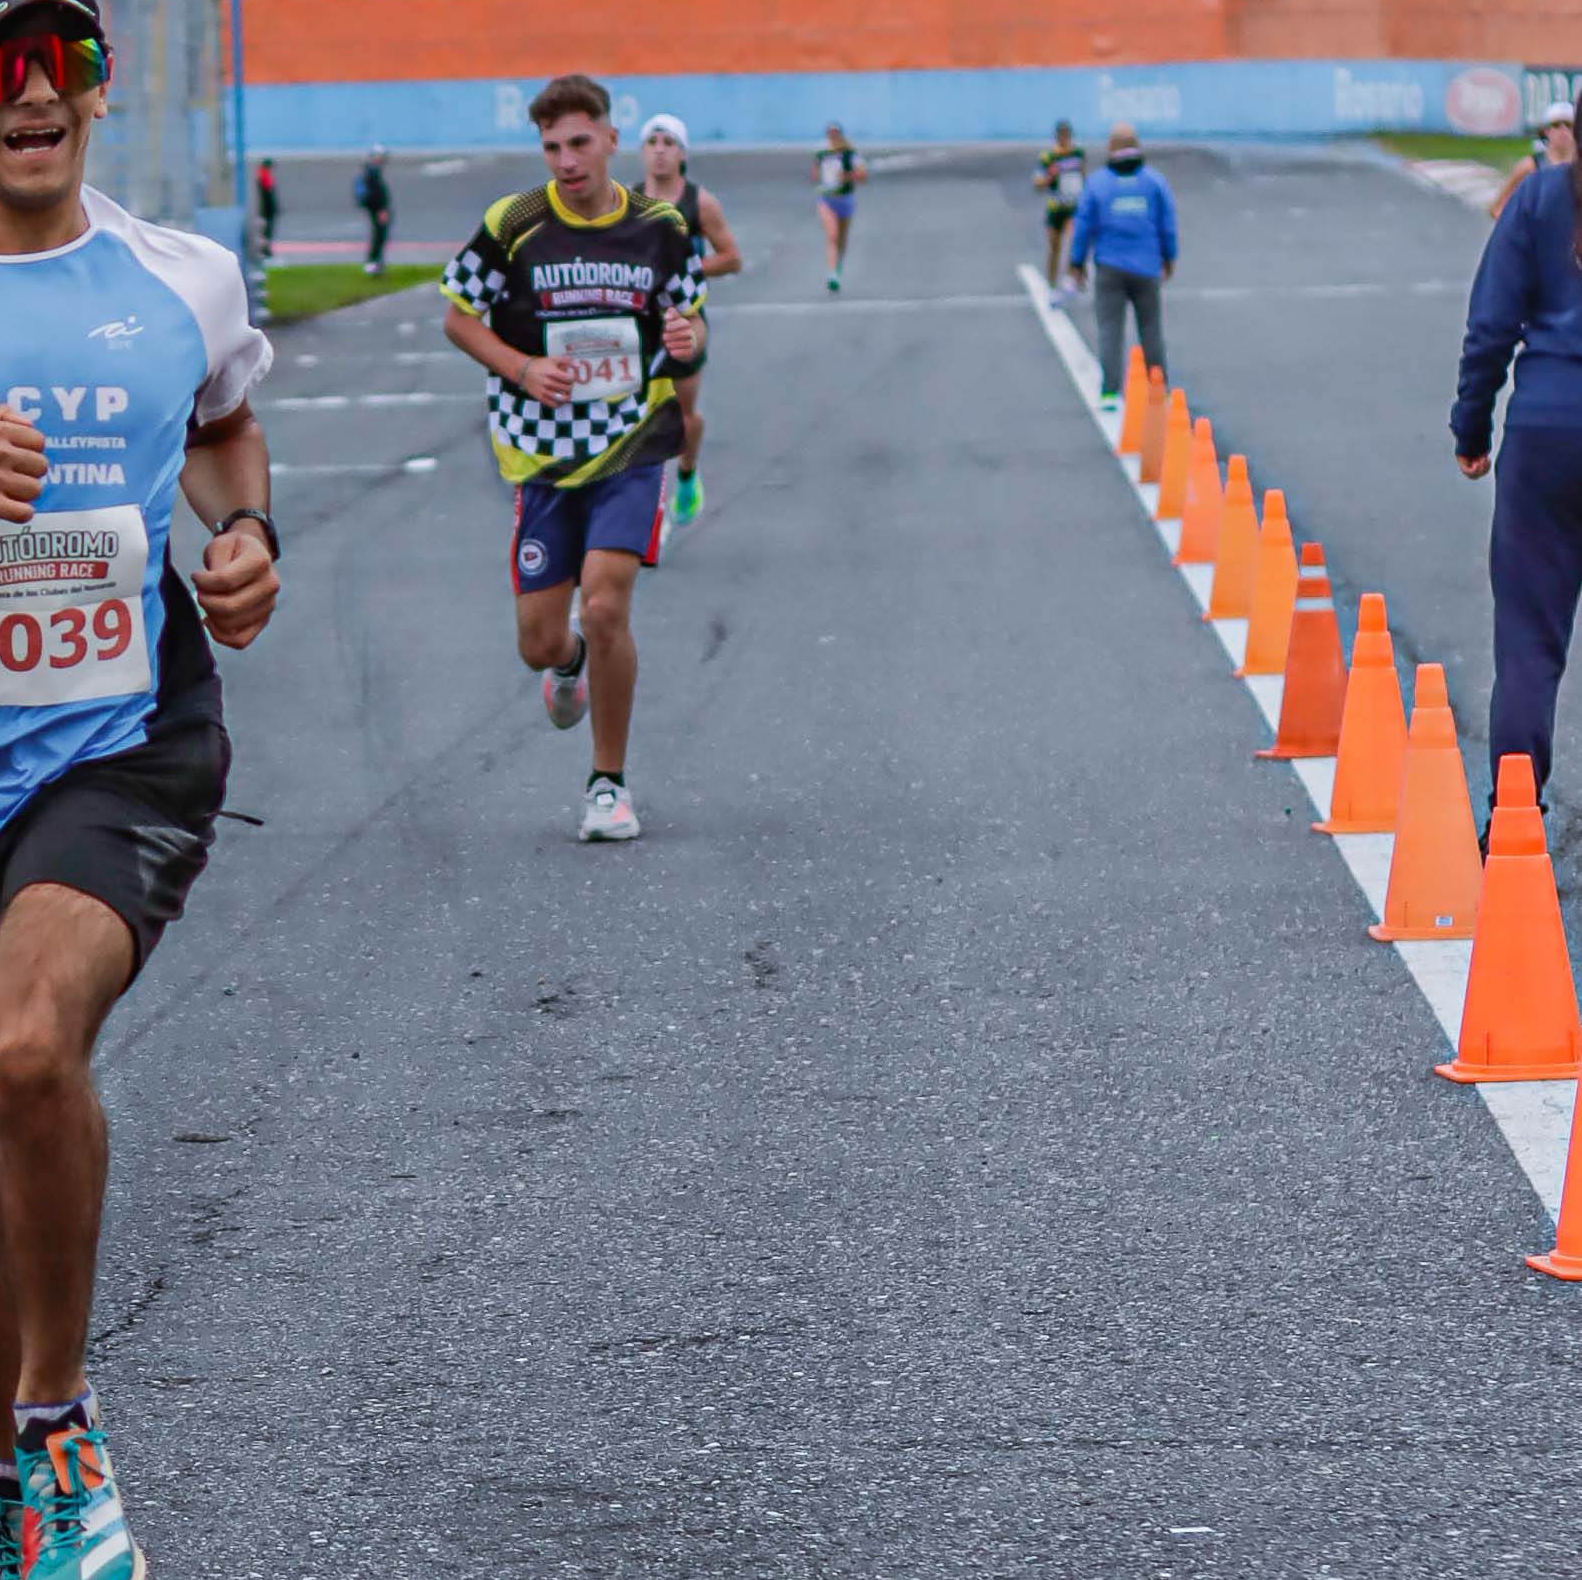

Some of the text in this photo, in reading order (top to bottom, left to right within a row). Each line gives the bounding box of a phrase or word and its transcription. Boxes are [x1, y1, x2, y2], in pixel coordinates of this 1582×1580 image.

[533, 256, 654, 290] AUTÓDROMO
[606, 288, 635, 307] RACE
[571, 357, 634, 385] 041
[39, 463, 127, 485] NTINA
[60, 562, 95, 578] RACE
